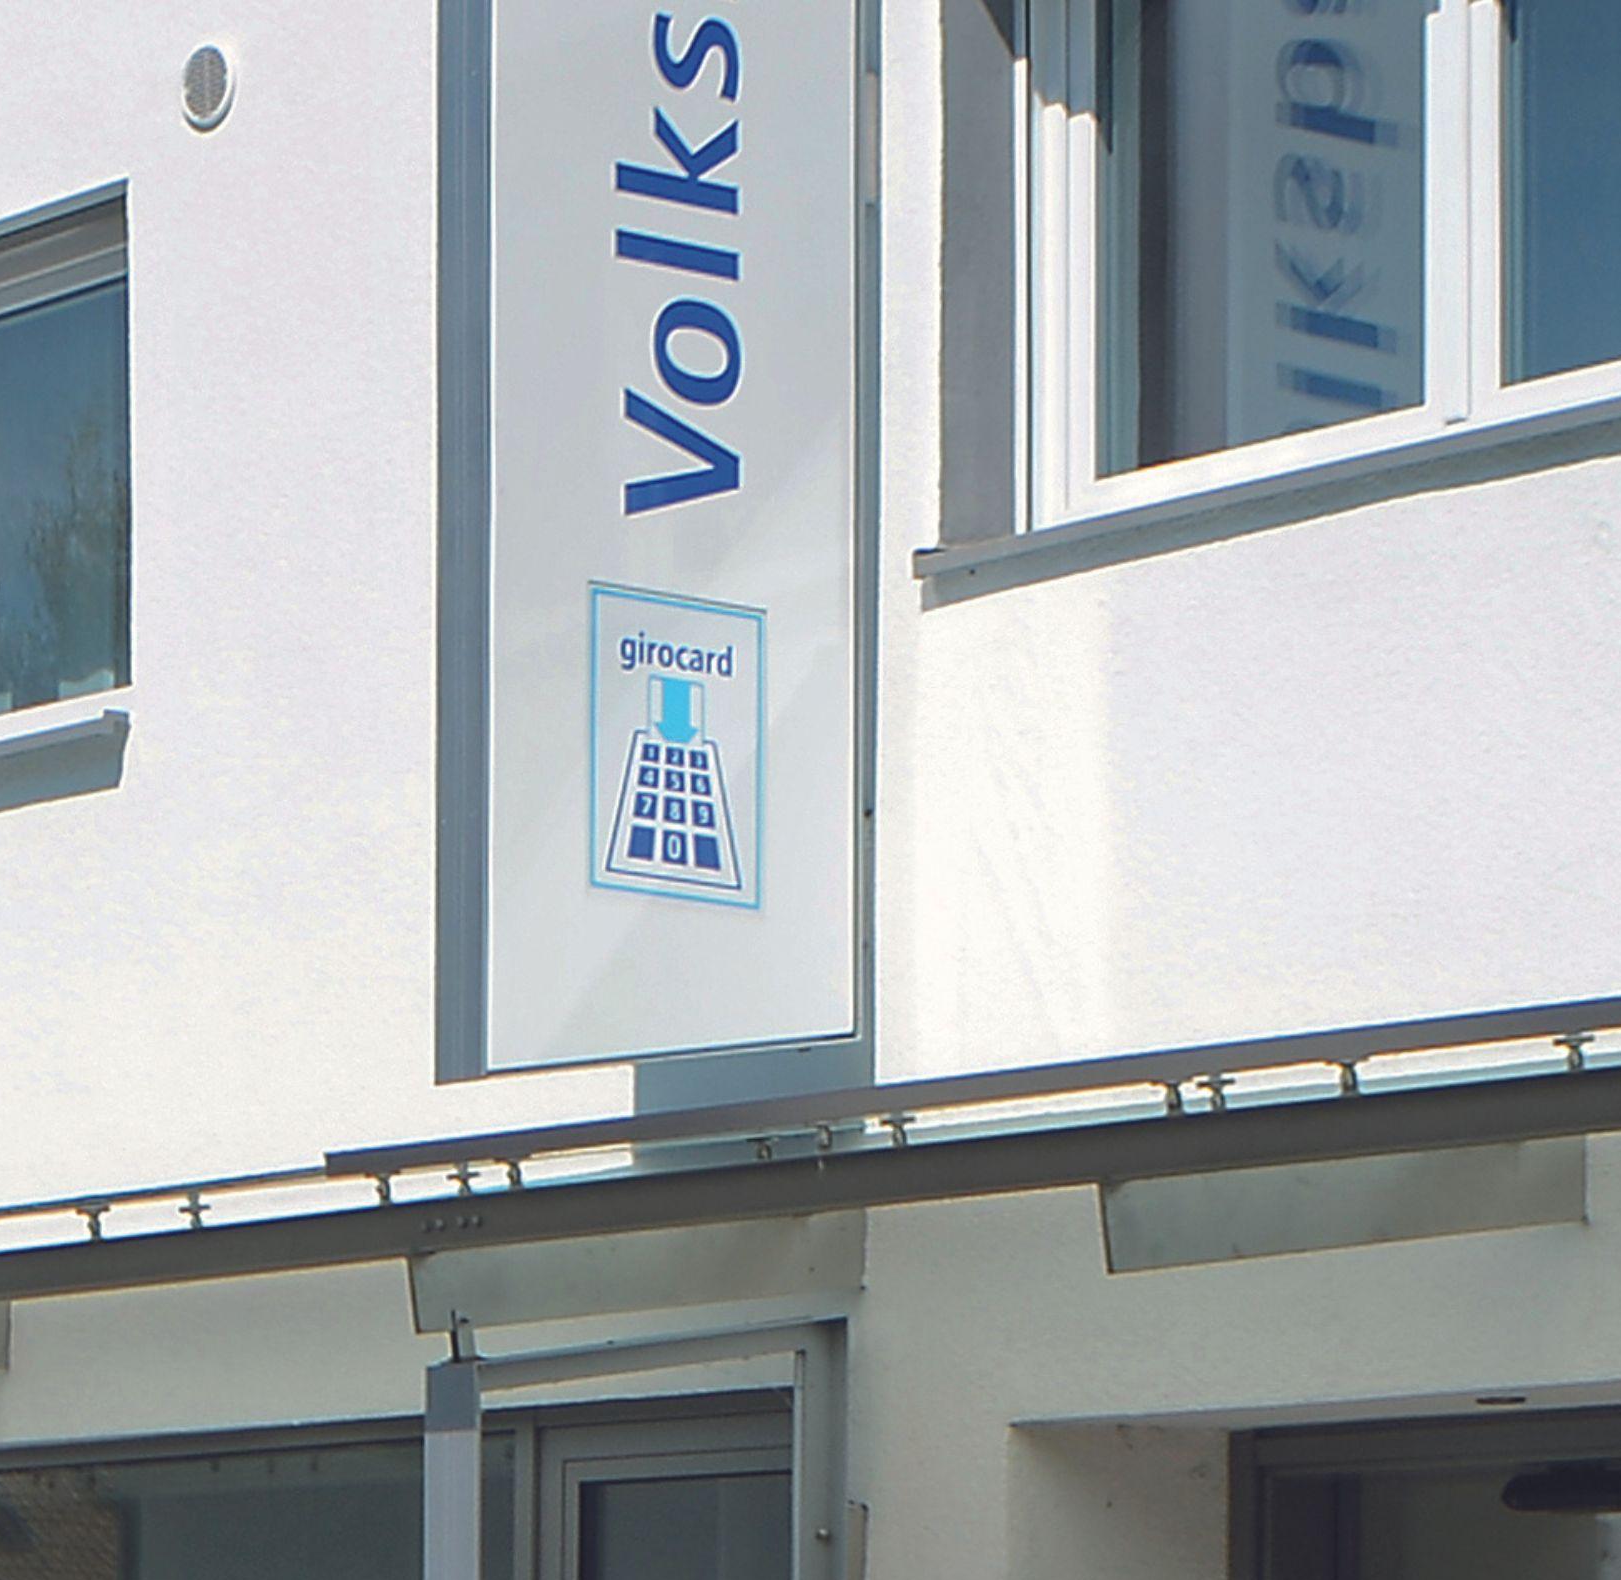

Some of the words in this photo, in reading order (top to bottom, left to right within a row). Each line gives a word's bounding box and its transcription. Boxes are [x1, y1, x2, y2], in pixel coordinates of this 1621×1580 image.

[614, 10, 742, 516] Volks
[619, 631, 733, 677] girocard
[640, 796, 654, 815] 7
[669, 801, 682, 821] 8
[697, 805, 710, 825] 9
[667, 833, 682, 860] 0
